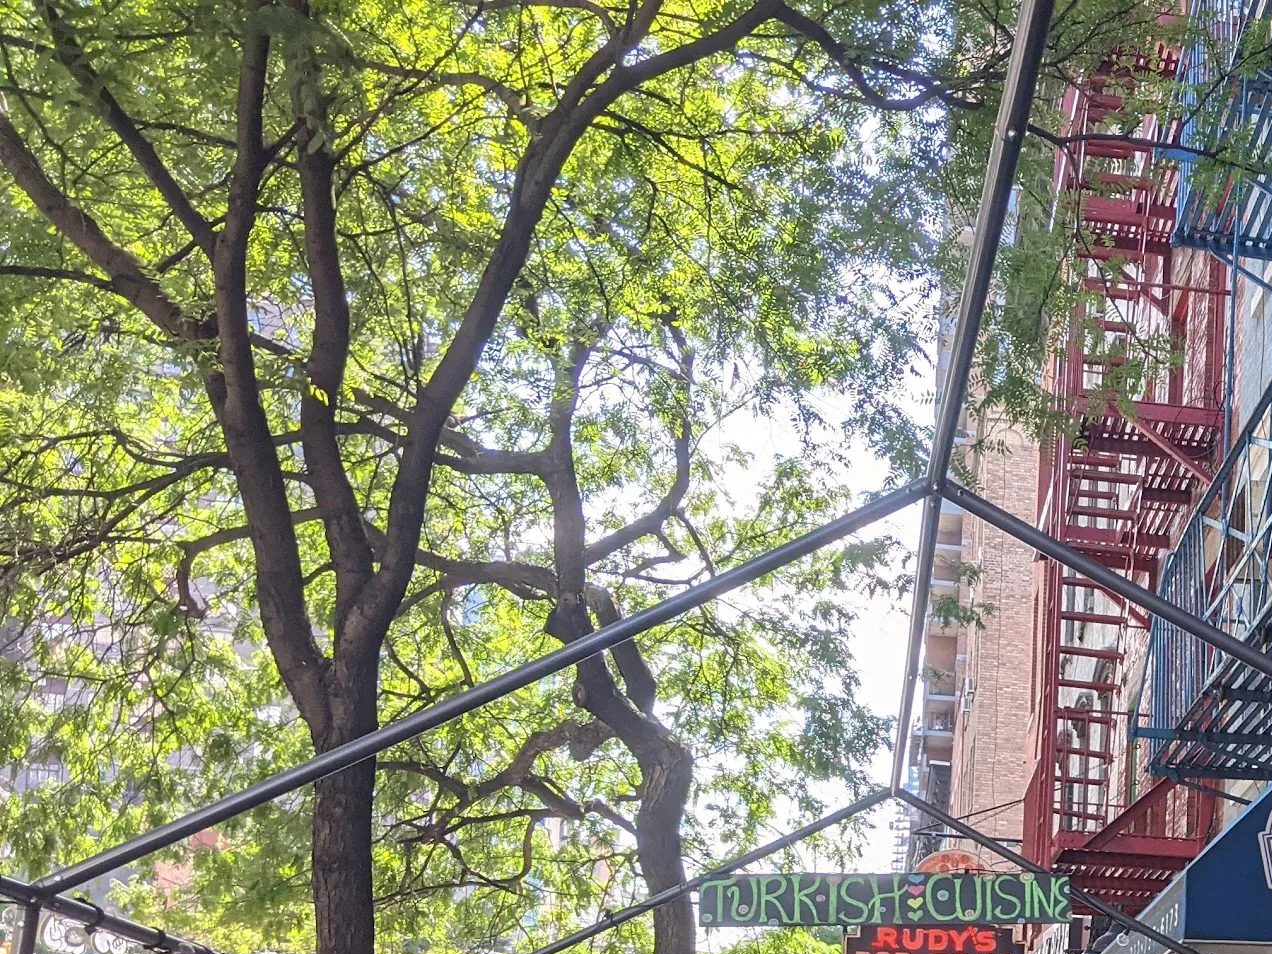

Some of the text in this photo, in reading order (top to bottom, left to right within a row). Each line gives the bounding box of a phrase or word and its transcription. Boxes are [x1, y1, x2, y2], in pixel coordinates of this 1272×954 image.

[700, 873, 1070, 925] TURKISH CUISINE
[871, 925, 998, 952] RUDY'S
